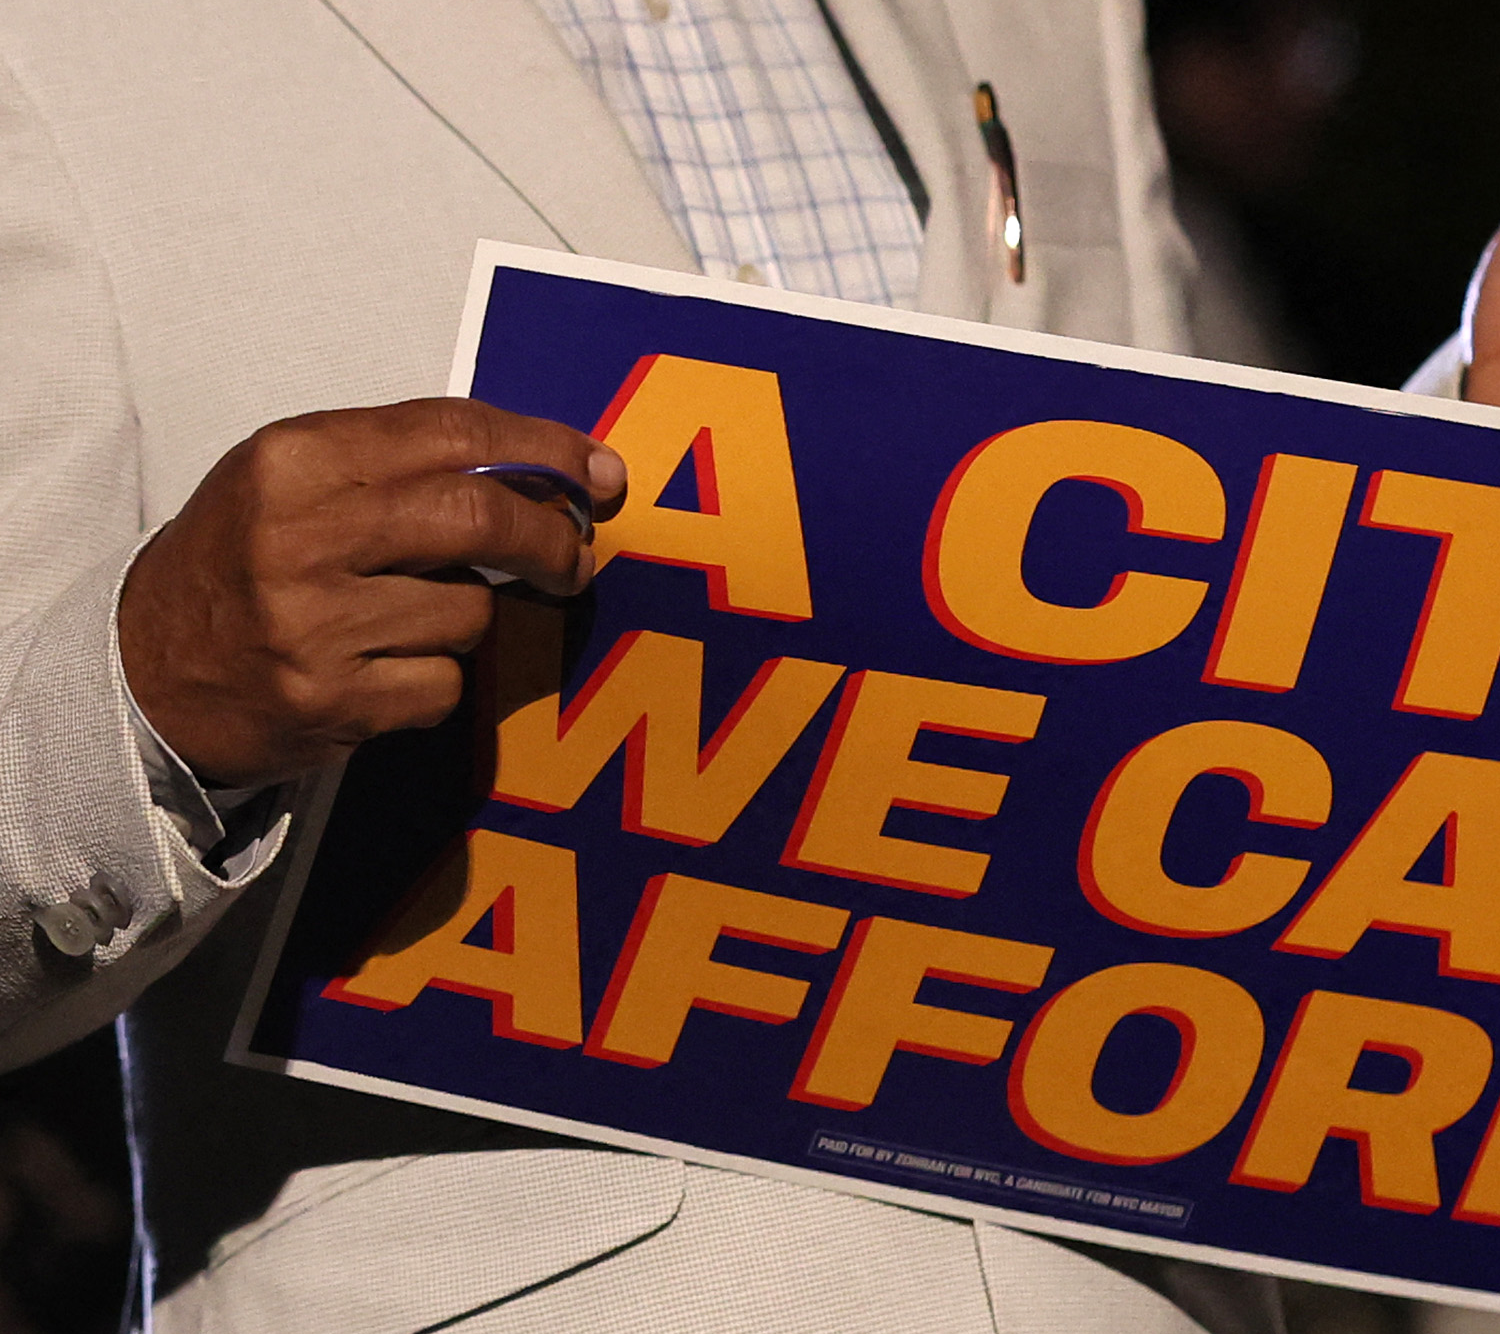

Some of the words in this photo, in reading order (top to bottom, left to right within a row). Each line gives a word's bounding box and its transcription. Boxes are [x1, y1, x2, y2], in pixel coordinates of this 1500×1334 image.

[590, 353, 815, 623] A
[487, 599, 1048, 900] WE
[817, 1136, 849, 1154] PAID
[849, 1142, 875, 1159] FOR
[874, 1148, 895, 1162] BY
[894, 1152, 947, 1174] ZOHRAN
[946, 1163, 975, 1179] FOR
[1004, 1174, 1015, 1187] A
[1015, 1176, 1084, 1201] CANDIDATE
[1084, 1189, 1113, 1206] FOR
[1111, 1194, 1140, 1210] NYC
[1138, 1200, 1186, 1218] MAYOR
